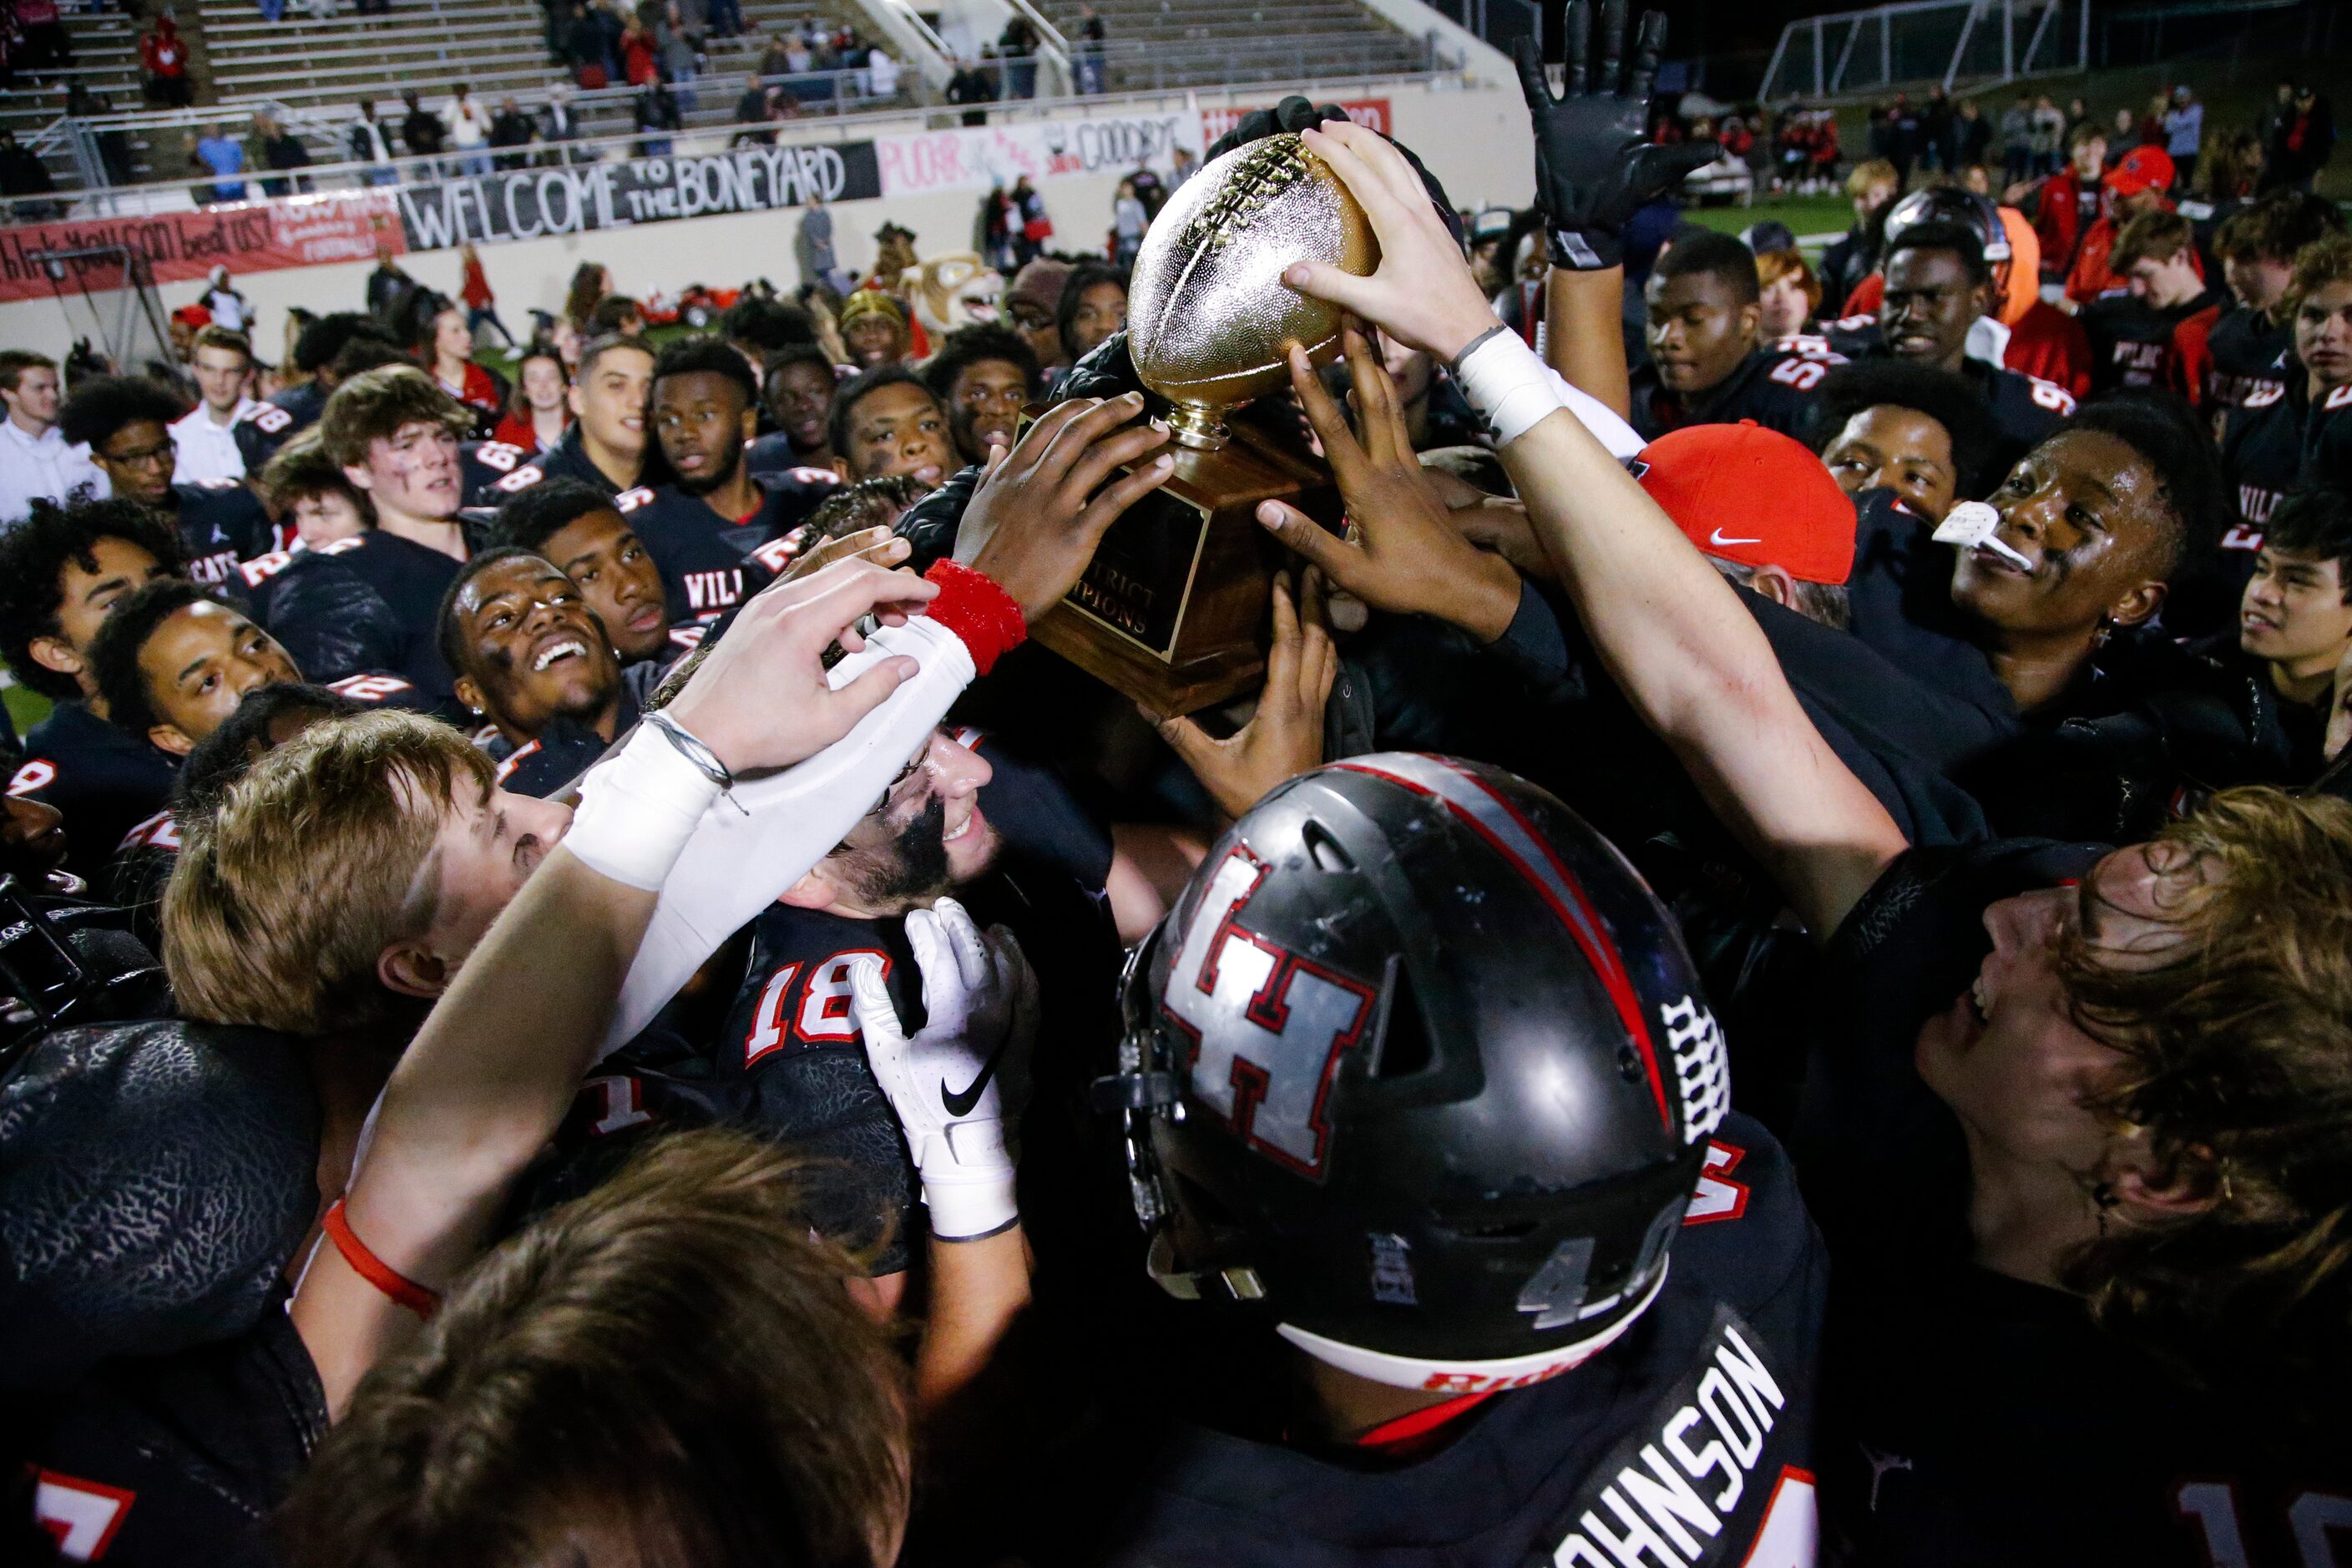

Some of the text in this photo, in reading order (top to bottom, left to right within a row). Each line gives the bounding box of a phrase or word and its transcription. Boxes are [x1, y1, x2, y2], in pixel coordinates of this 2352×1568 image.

[402, 164, 632, 247] WELCOME
[627, 189, 679, 221] THE
[630, 159, 669, 185] TO
[675, 145, 845, 216] BONEYARD
[745, 948, 894, 1070] 18
[1543, 1324, 1788, 1568] OHNSON
